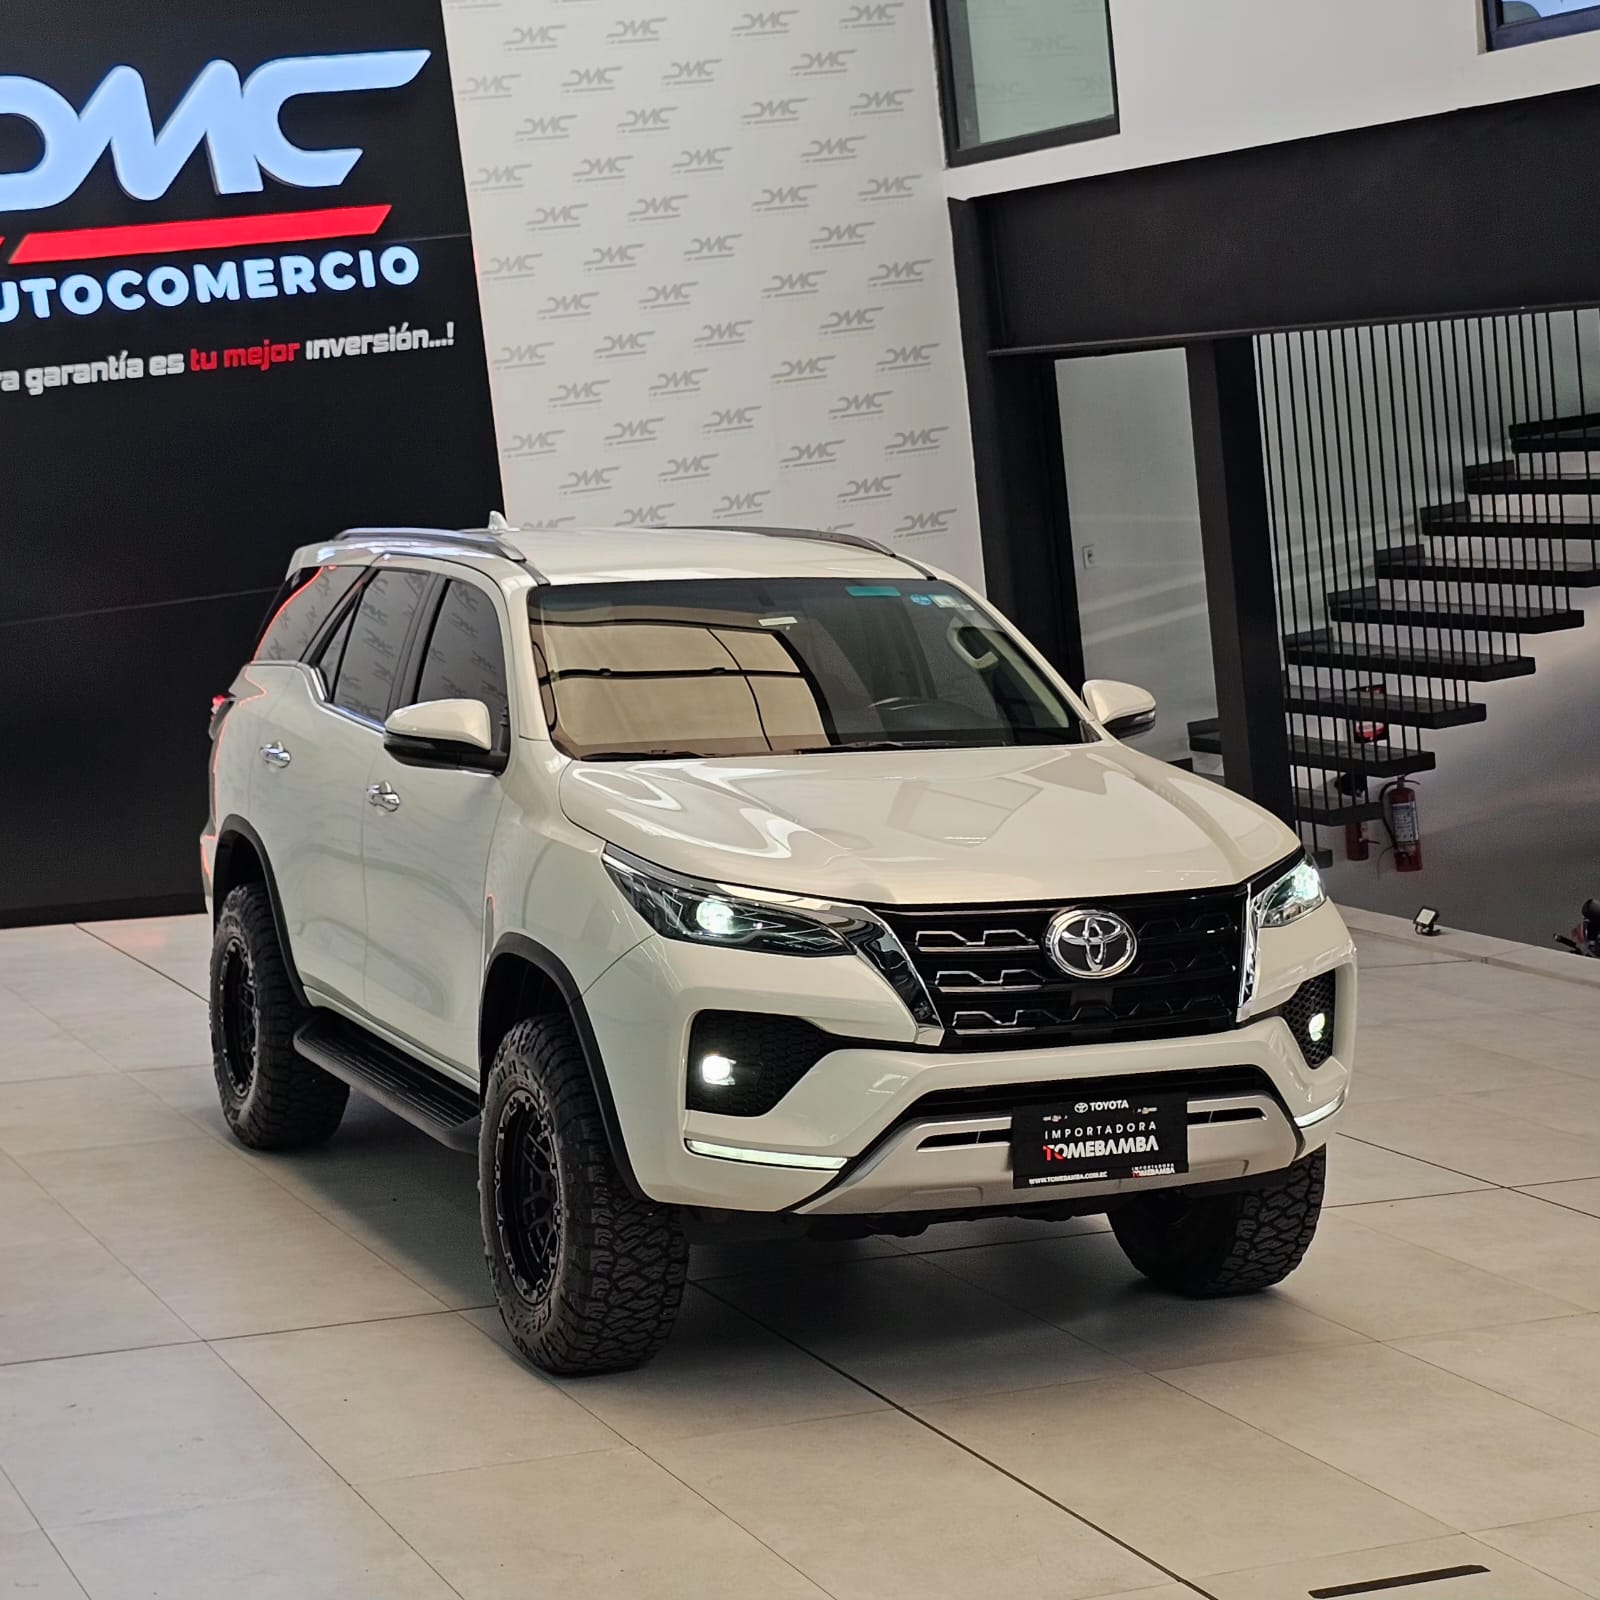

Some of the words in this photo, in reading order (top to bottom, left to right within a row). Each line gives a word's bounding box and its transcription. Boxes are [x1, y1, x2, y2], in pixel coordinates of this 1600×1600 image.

[25, 351, 144, 395] garantía
[149, 353, 185, 376] es
[190, 348, 217, 371] tu
[223, 339, 300, 370] mejor
[1089, 1100, 1129, 1112] TOYOTA
[1045, 1122, 1156, 1139] IMPORTADORA
[1042, 1136, 1159, 1160] TOMEBAMBA
[1029, 1171, 1108, 1184] WWW.TOMEBAMBA.COM.EC
